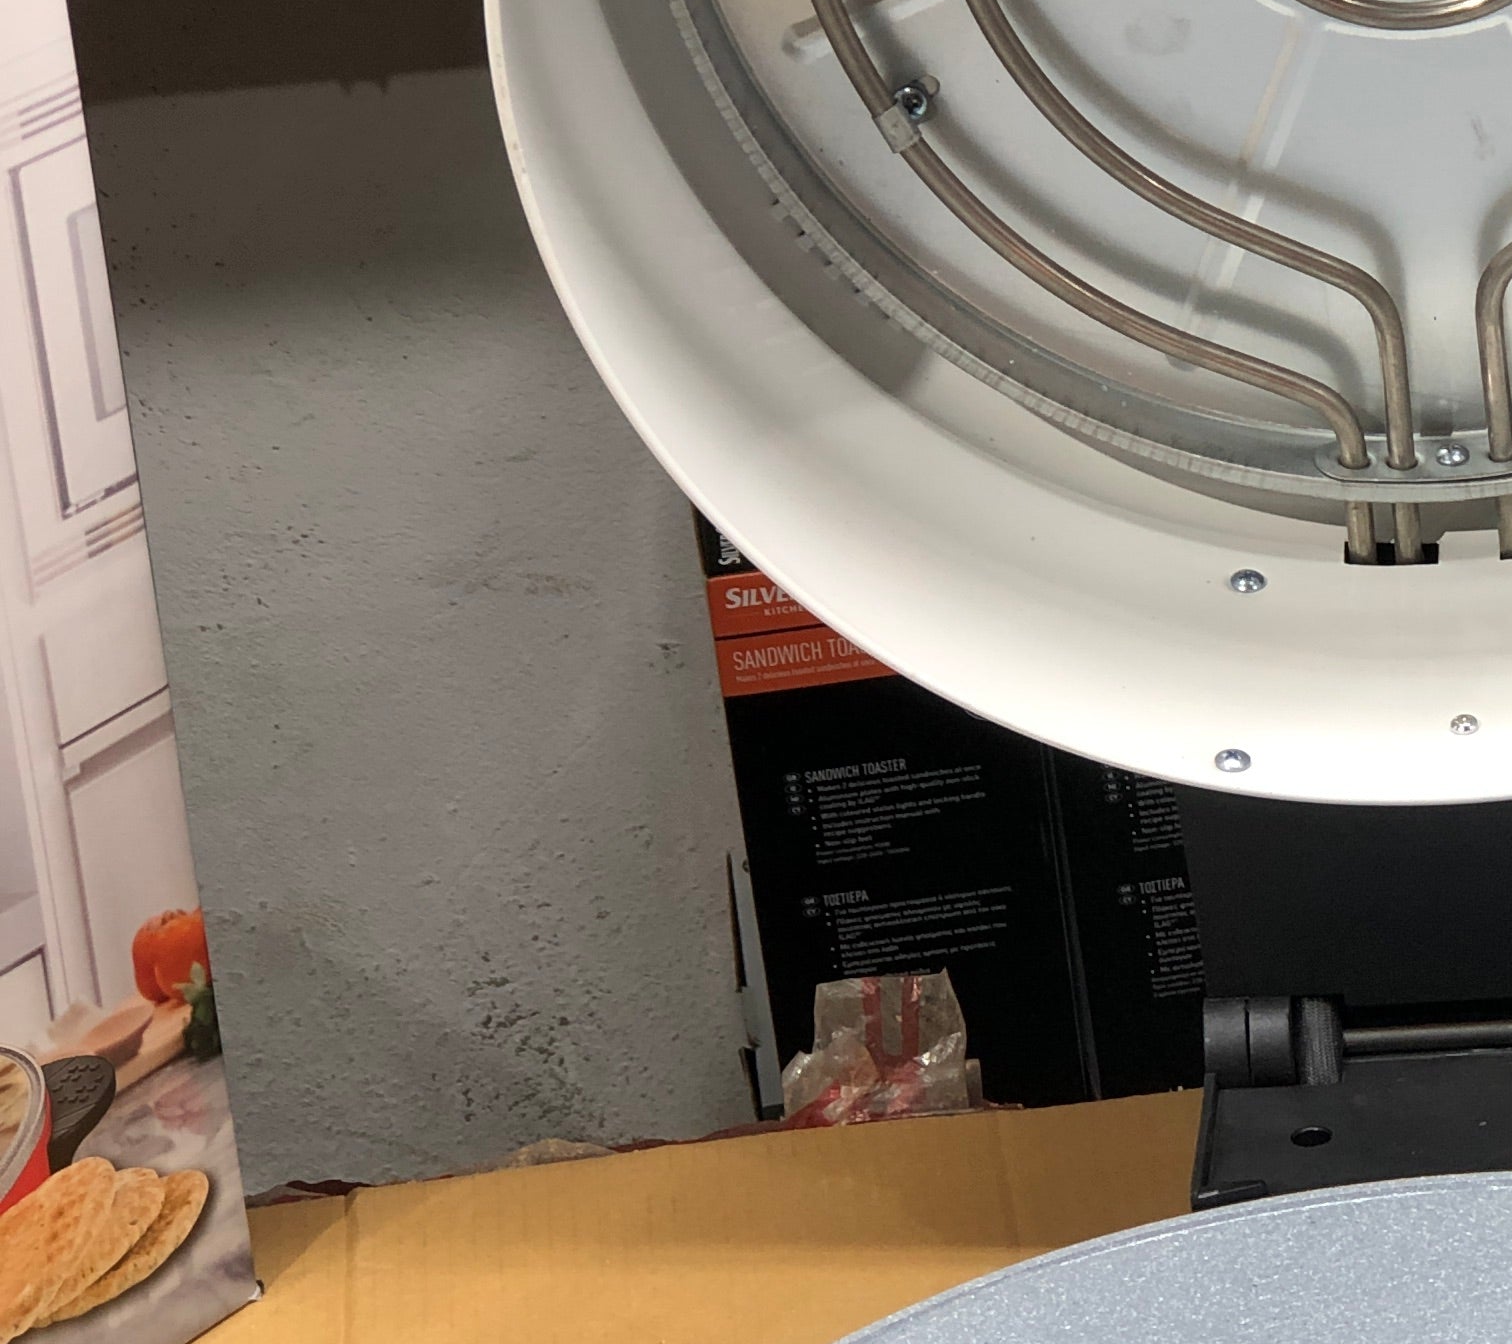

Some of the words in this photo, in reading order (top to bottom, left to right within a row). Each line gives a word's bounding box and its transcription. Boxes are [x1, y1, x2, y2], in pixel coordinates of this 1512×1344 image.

[725, 586, 797, 609] SILVE
[733, 641, 823, 671] SANDWICH
[804, 764, 860, 783] SANDWICH
[862, 758, 908, 775] TOASTER
